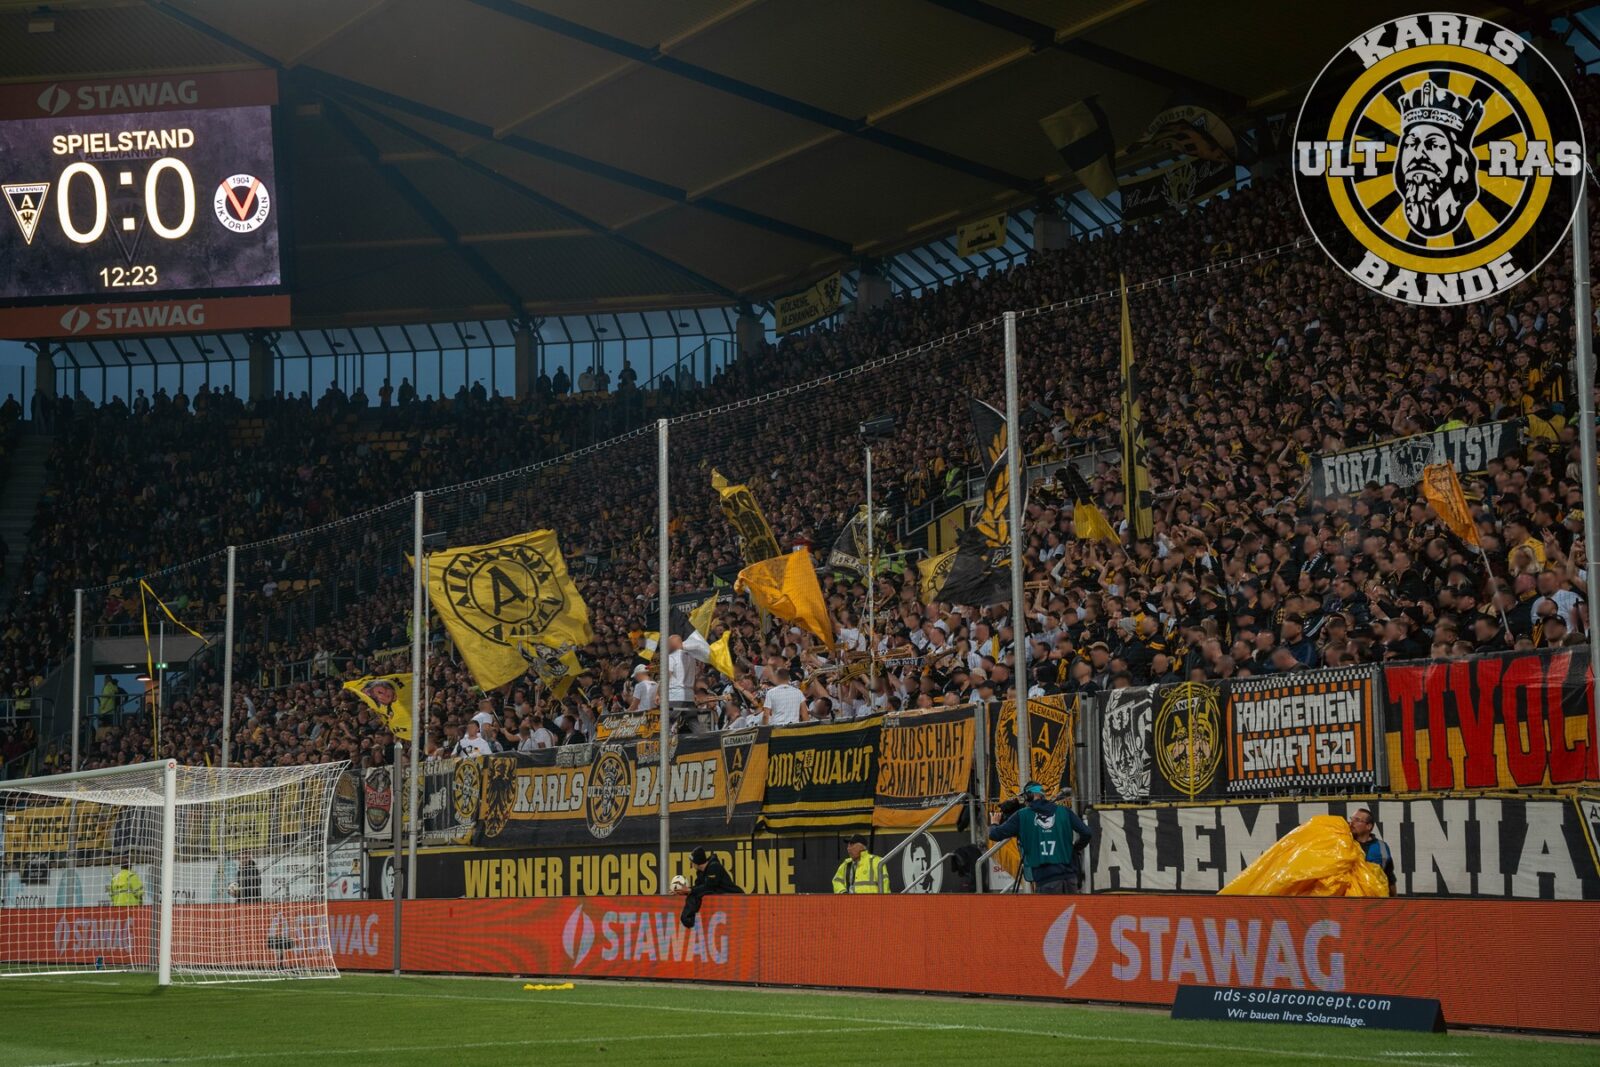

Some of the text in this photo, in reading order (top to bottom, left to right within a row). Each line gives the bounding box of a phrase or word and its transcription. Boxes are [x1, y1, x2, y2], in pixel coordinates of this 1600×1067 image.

[77, 80, 199, 110] STAWAG
[52, 128, 195, 155] SPIELSTAND
[232, 176, 250, 184] 1904
[20, 194, 35, 209] A
[100, 265, 158, 287] 12:23
[96, 304, 205, 329] STAWAG
[1322, 424, 1503, 496] FORZA ATSV
[1235, 690, 1361, 733] FAHRGEMEIN
[1036, 722, 1049, 748] A
[812, 745, 874, 785] WACHT
[1243, 731, 1356, 771] SCHAFT 520
[512, 772, 585, 813] KARLS
[1040, 841, 1056, 856] 17
[1093, 800, 1584, 900] ALEMNNIA
[464, 856, 564, 898] WERNER
[570, 852, 658, 897] FUCHS
[601, 911, 729, 964] STAWAG
[1110, 915, 1346, 992] STAWAG
[1214, 989, 1391, 1010] nds-solarconcept.com
[1227, 1008, 1366, 1027] Wir bauen Ihre Solaranlage.
